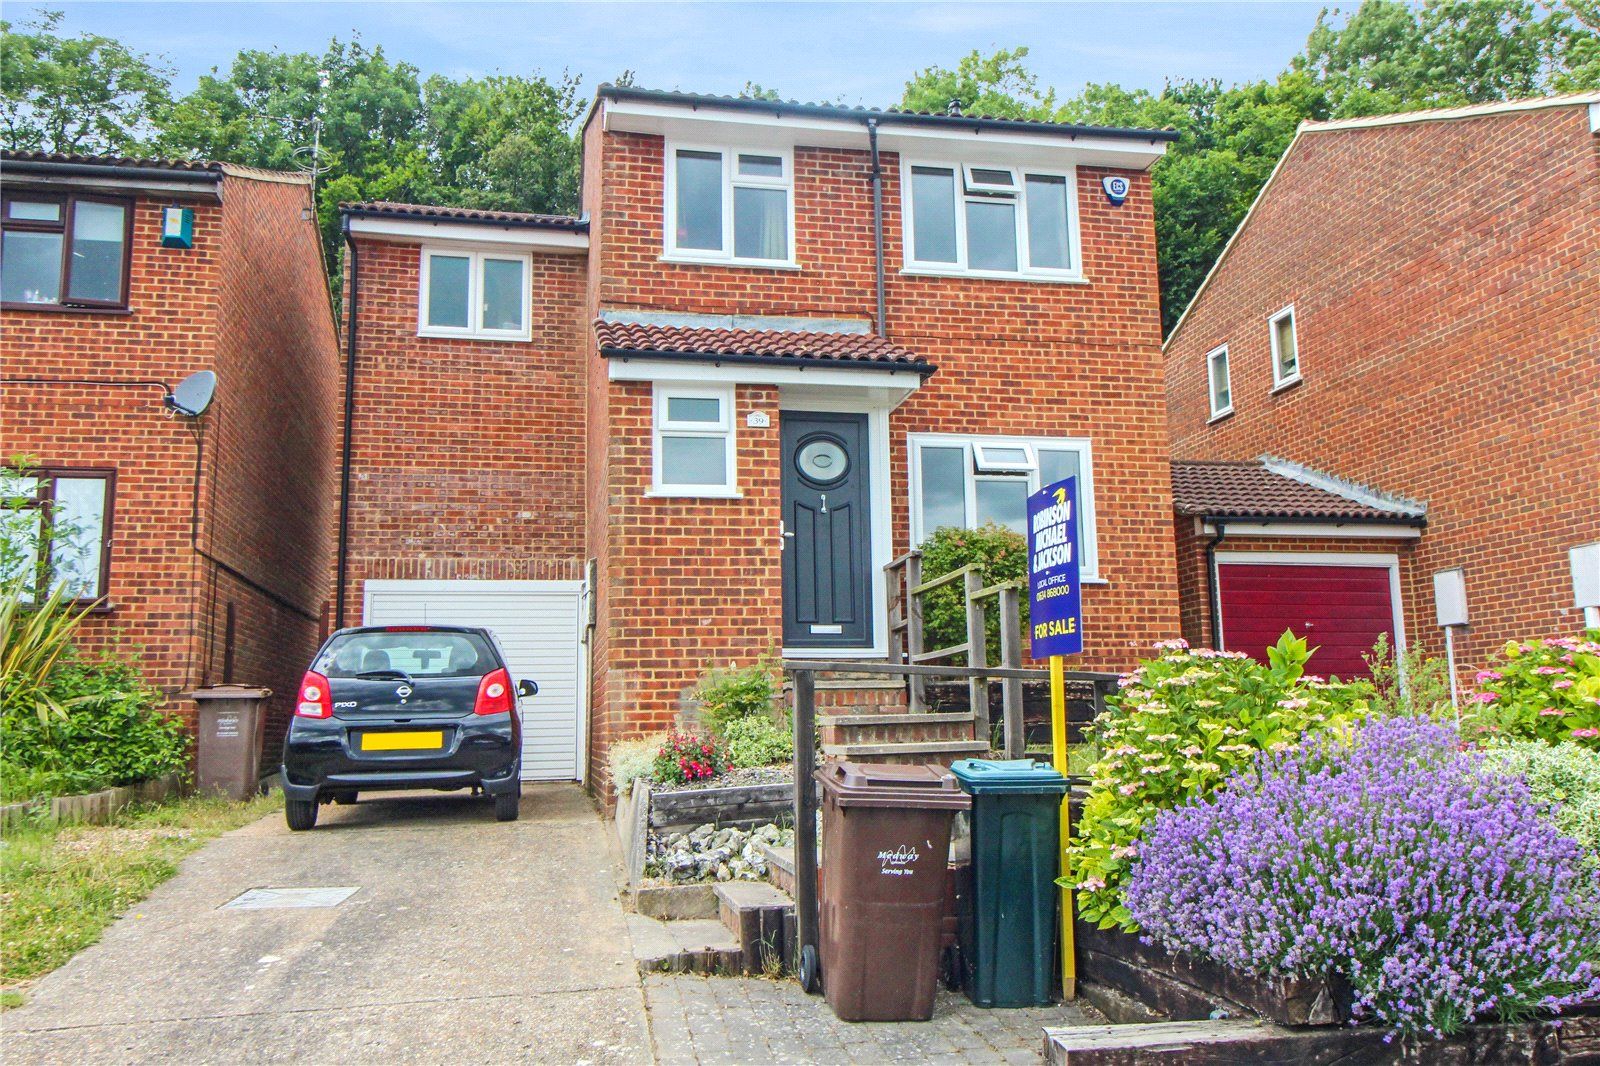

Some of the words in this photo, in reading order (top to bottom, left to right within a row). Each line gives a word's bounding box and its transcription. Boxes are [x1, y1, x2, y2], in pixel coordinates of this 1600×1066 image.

[753, 417, 764, 425] 39
[1033, 500, 1071, 534] ROBINSON
[1035, 522, 1068, 553] MICHAEL
[1048, 574, 1066, 585] OFFICE
[1034, 624, 1048, 640] FOR
[1049, 617, 1076, 635] SALE
[877, 851, 920, 862] Medway
[881, 868, 903, 876] Serving
